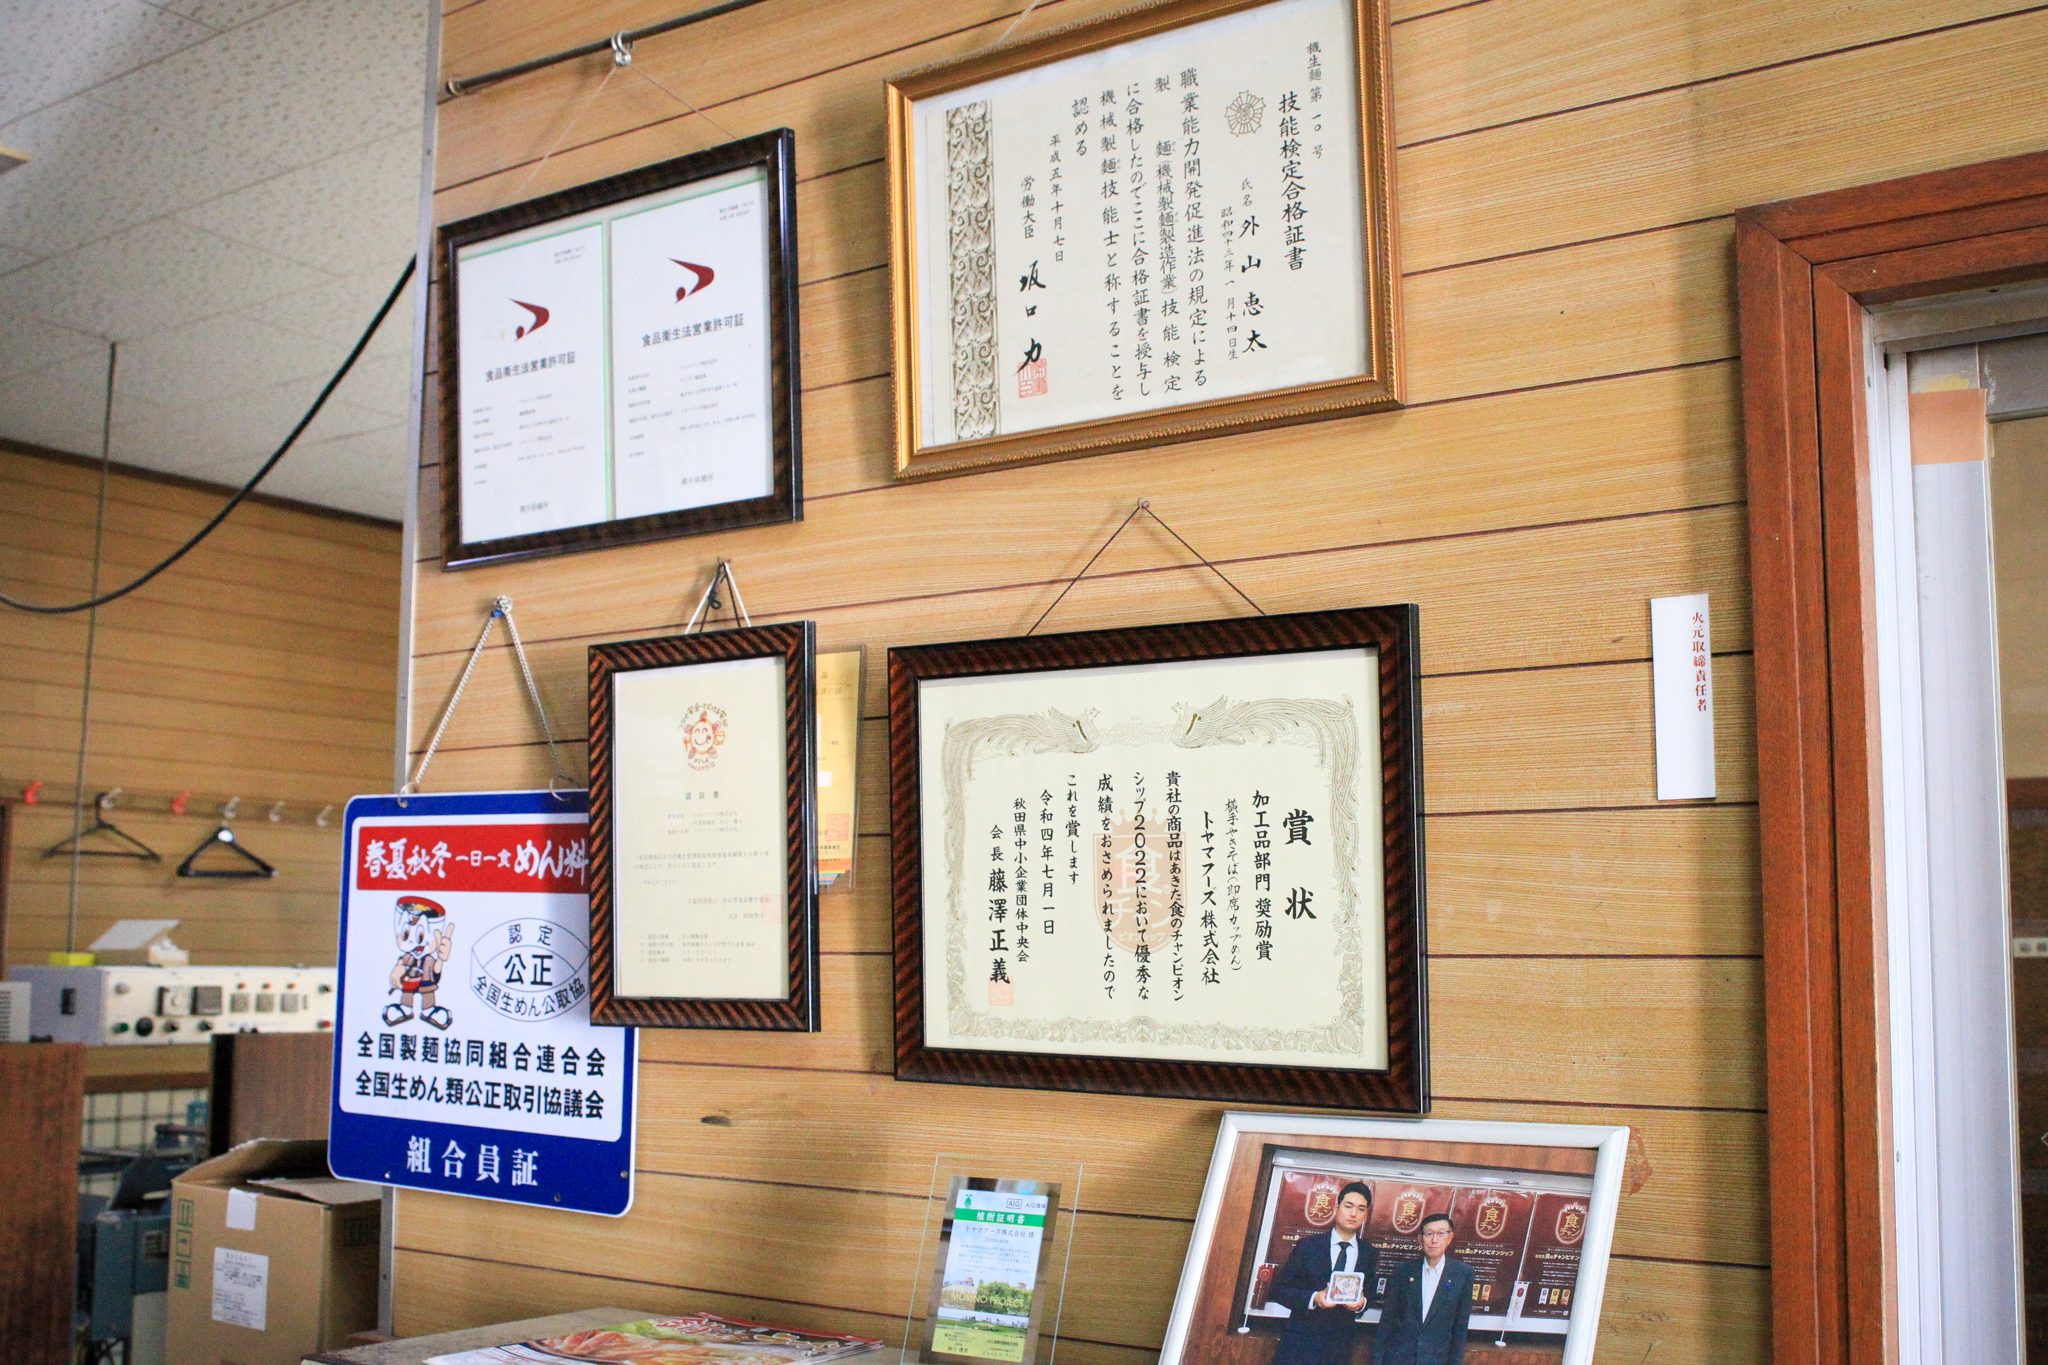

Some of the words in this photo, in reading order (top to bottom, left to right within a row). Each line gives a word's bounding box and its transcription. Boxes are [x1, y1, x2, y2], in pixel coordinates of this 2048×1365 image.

[1072, 97, 1089, 156] 認める
[1020, 176, 1036, 239] 労働大臣
[1049, 134, 1064, 262] 平成五年十月七日
[1242, 178, 1252, 208] 氏名
[1279, 91, 1308, 270] 技能検定合格証書
[1126, 83, 1152, 396] に合格したのでここに合格証書を授与し
[1180, 68, 1208, 387] 職業能力開発促進法の規定による
[1013, 260, 1046, 376] 坂口力
[1239, 215, 1267, 353] 外山恵太
[485, 351, 576, 382] 食品衛生法営業許可証
[641, 313, 744, 347] 食品衛生法営業許可証
[1692, 611, 1707, 712] 火元取締責任者
[990, 824, 1004, 861] 会長
[1039, 789, 1055, 935] 令和四年七月一日
[1065, 774, 1081, 885] これを賞します
[1283, 808, 1318, 920] 賞状
[1013, 797, 1030, 962] 秋田県中小企業団体中央会
[1097, 773, 1116, 999] 成績をおさめられましたので
[1133, 771, 1151, 1000] シップ2022において優秀な
[1165, 770, 1185, 1001] 貴社の商品はあきた食のチャンピオン
[1200, 810, 1221, 986] トヤマフーズ株式会社
[508, 923, 553, 946] 認定
[988, 868, 1010, 984] 藤澤正義
[473, 976, 586, 1017] 全国生めん公取協
[504, 953, 553, 986] 公正
[355, 1069, 604, 1120] 全国生めん類公正取引協議会
[357, 1031, 606, 1077] 全国製麺協同組合連合会
[406, 1135, 539, 1187] 組合員証
[966, 1226, 1026, 1238] トヤマフーズ株式会社
[976, 1211, 1026, 1225] 植樹証明書
[1008, 1200, 1020, 1208] AIG
[950, 1292, 988, 1304] MORINO
[989, 1295, 1025, 1308] PROJECT
